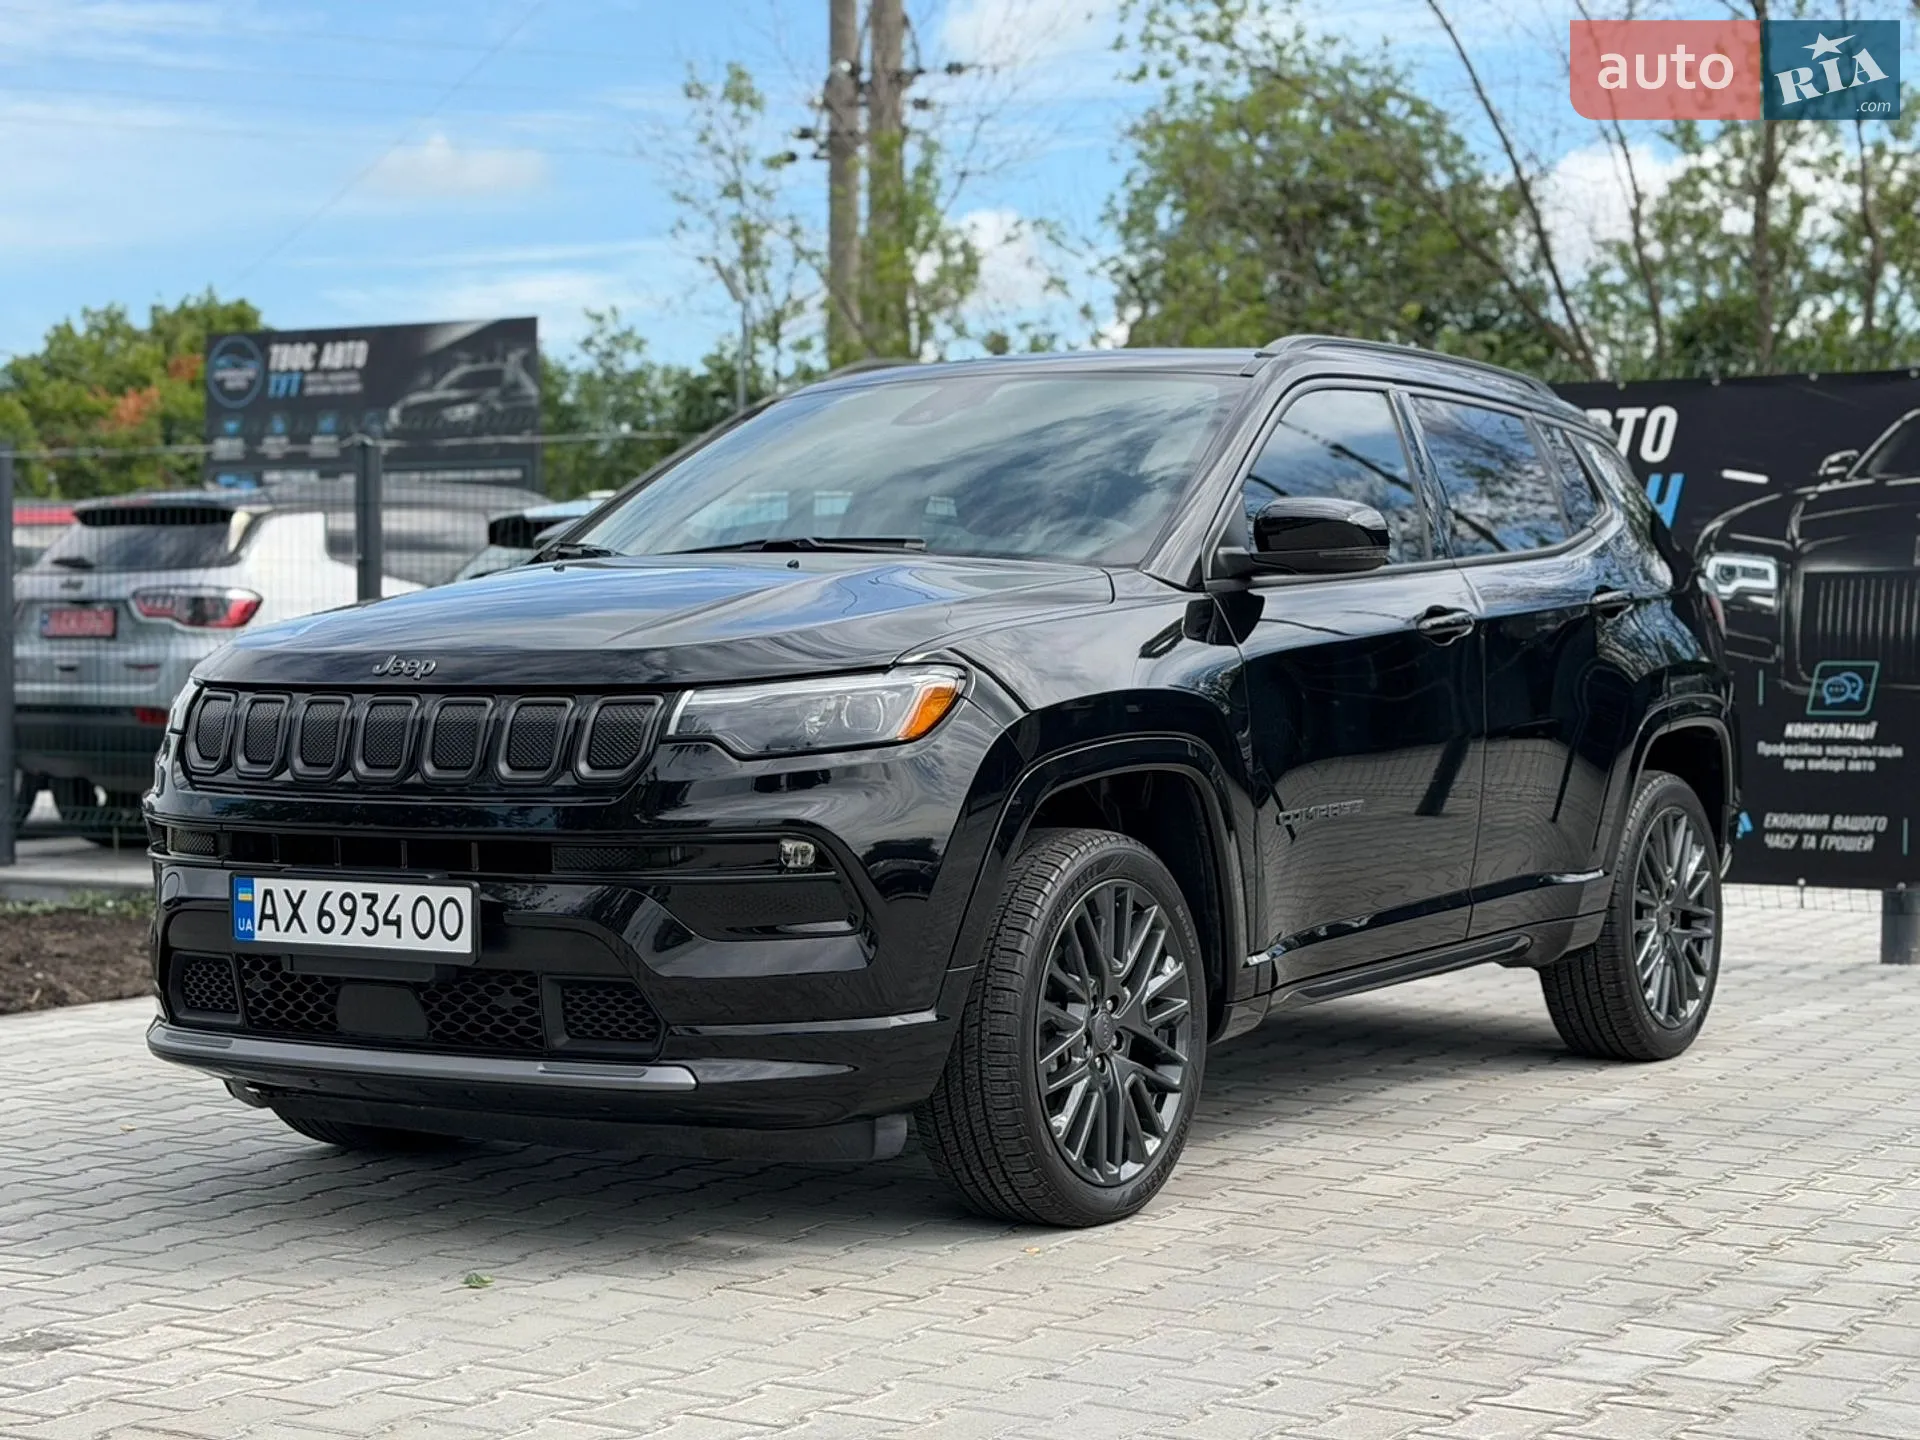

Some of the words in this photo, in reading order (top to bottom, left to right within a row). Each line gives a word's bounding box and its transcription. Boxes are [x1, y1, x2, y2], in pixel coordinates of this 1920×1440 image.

[372, 654, 436, 680] Jeep
[1763, 812, 1830, 830] ЕКОНОМІЯ
[1832, 814, 1888, 833] ВАШОГО
[1764, 833, 1799, 850] ЧАСУ
[1802, 834, 1817, 850] ТА
[238, 918, 254, 932] UA
